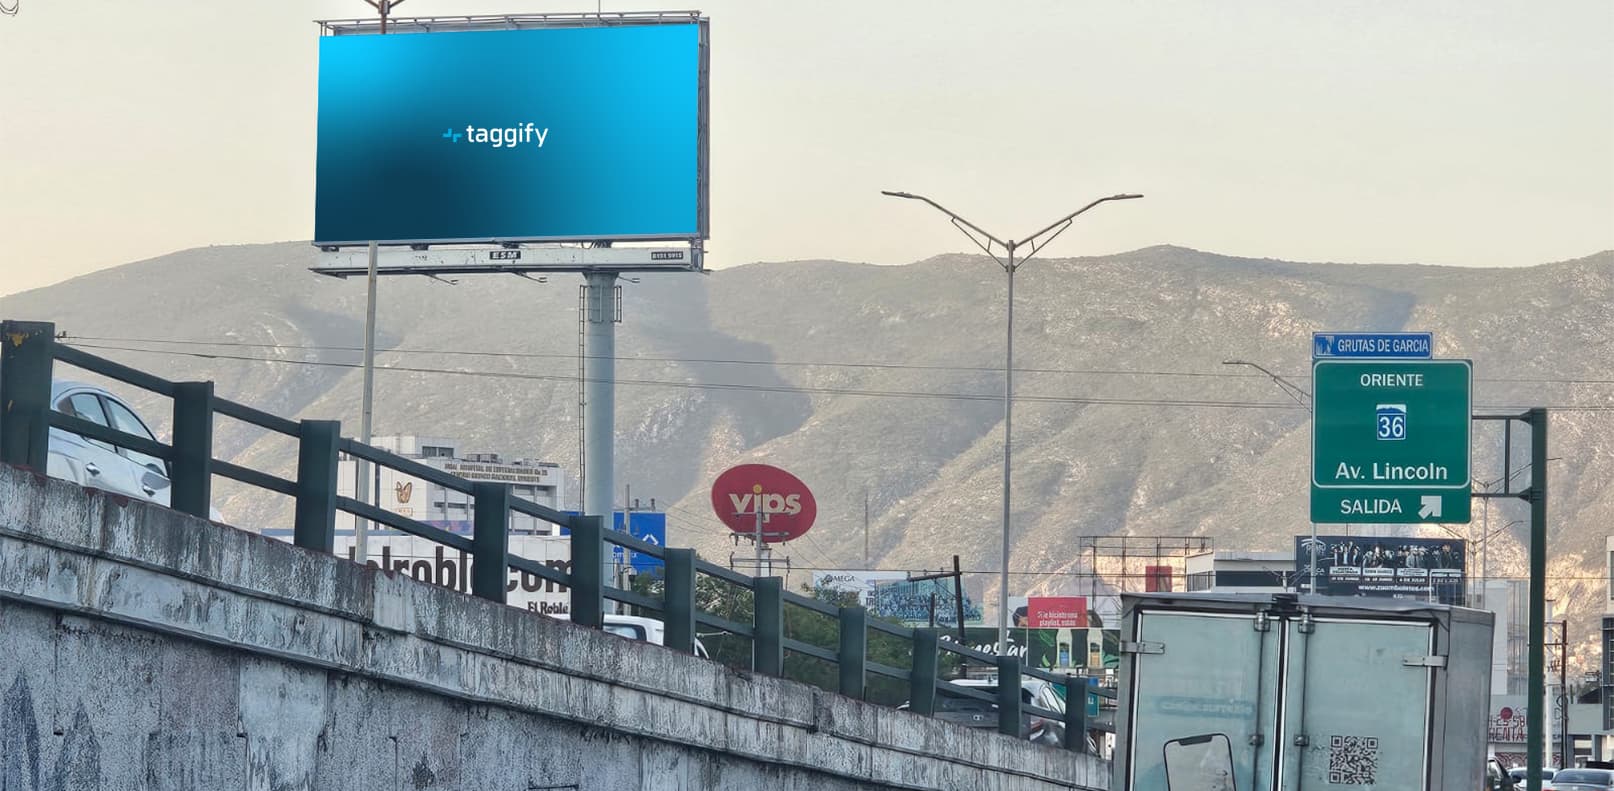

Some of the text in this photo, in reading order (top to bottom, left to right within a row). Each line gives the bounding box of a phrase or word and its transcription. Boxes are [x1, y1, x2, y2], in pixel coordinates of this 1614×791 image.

[466, 122, 549, 148] taggify
[1337, 339, 1429, 352] GRUTAS DE GARCIA
[1360, 373, 1424, 387] ORIENTE
[1379, 416, 1404, 438] 36
[1335, 462, 1448, 480] Av. Lincoln
[728, 484, 801, 523] vips
[1340, 499, 1402, 514] SALIDA
